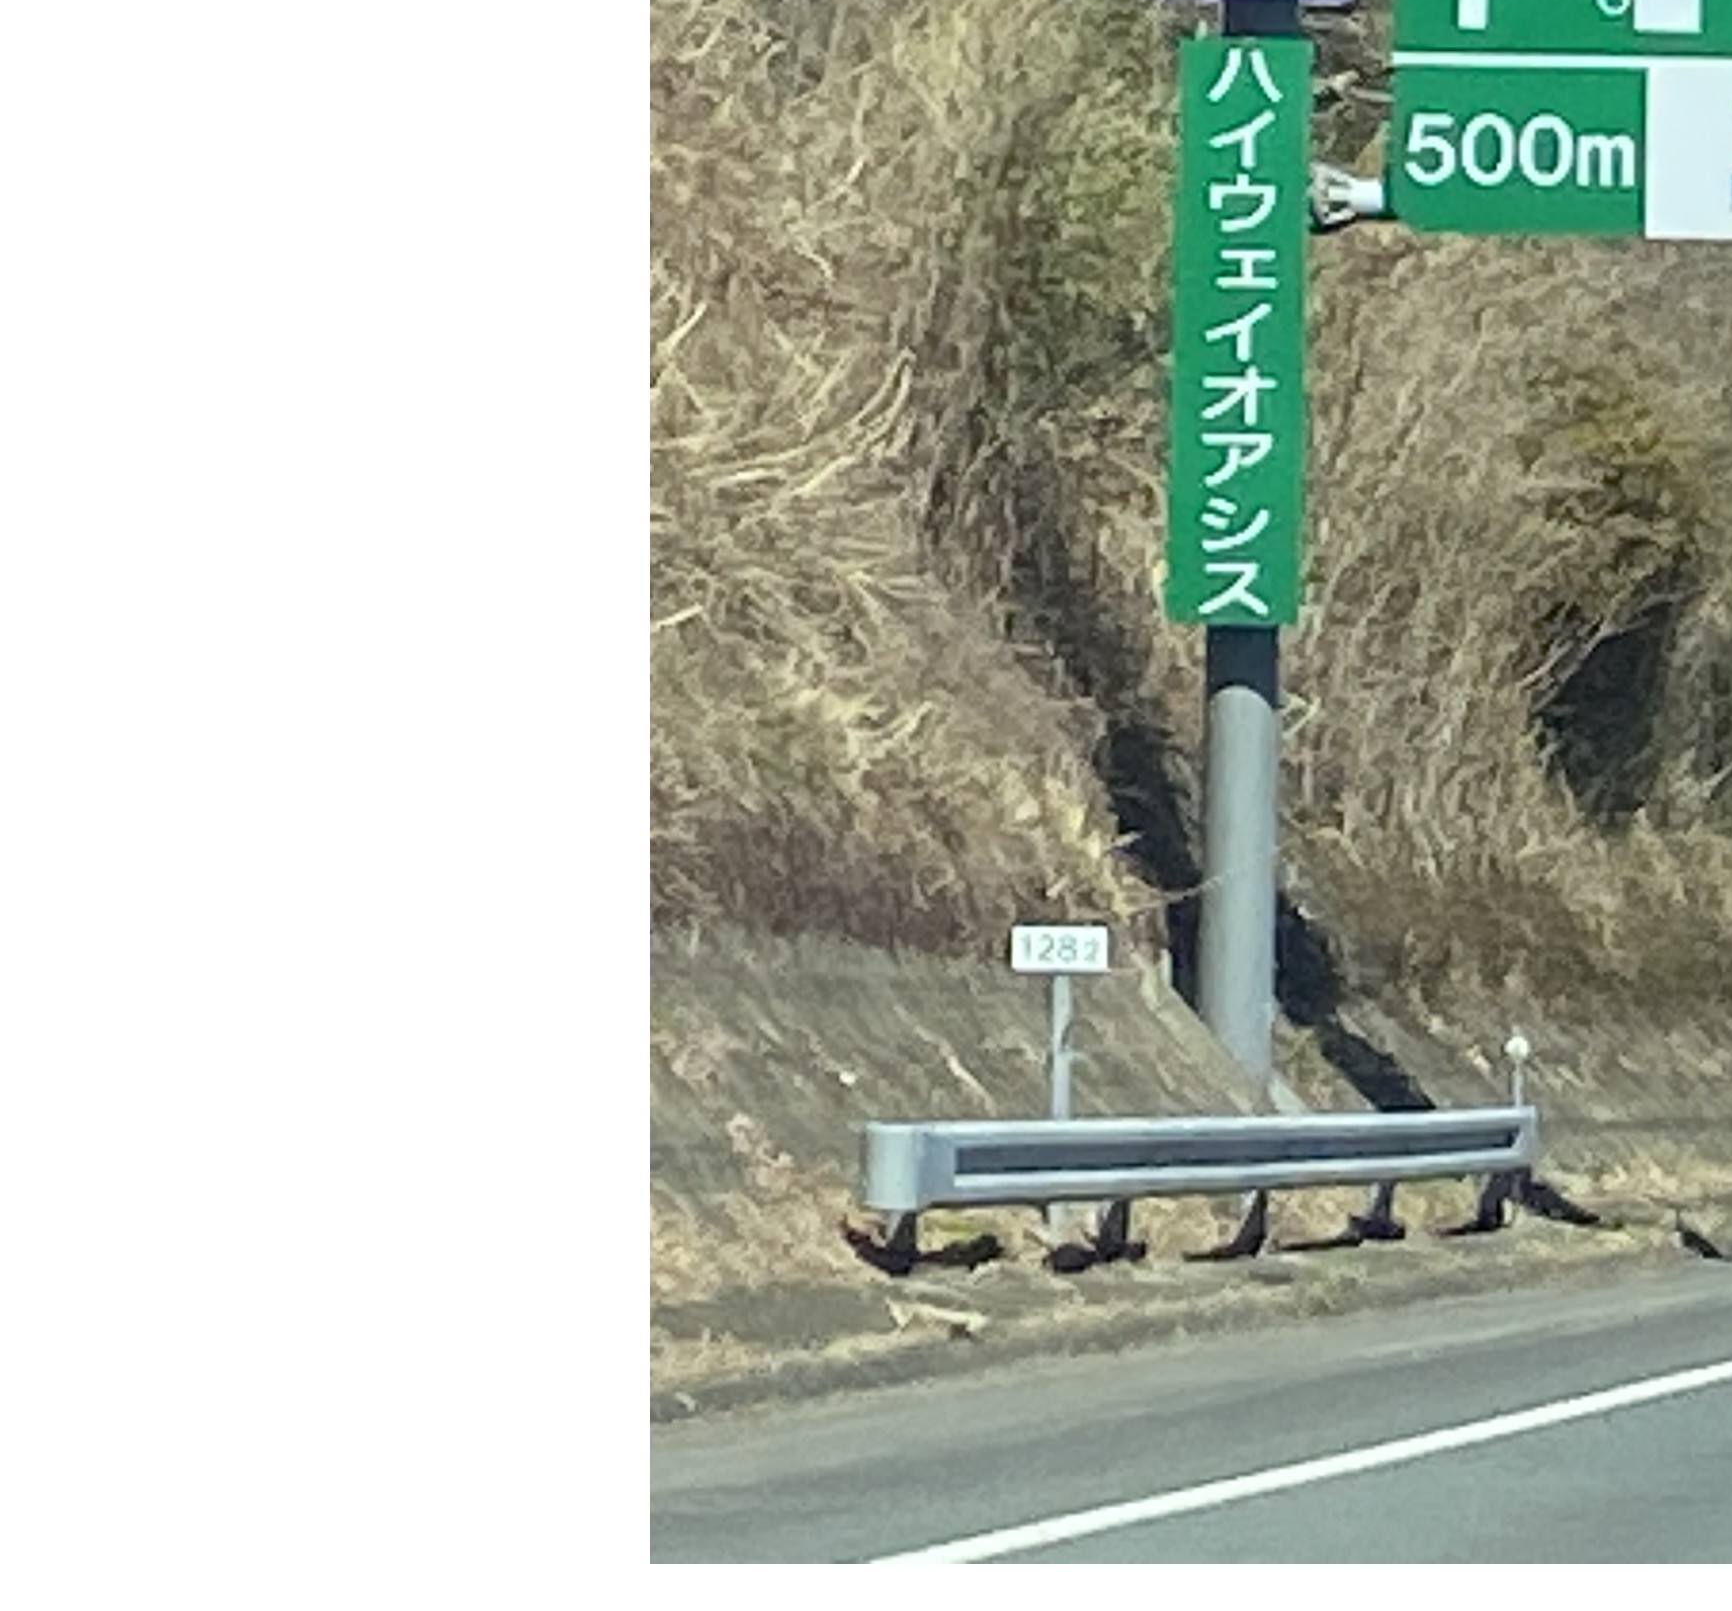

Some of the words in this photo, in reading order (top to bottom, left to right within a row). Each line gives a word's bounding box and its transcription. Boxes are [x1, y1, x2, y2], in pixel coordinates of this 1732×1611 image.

[1404, 112, 1636, 188] 500m
[1198, 46, 1283, 617] ハイウェイオアシス
